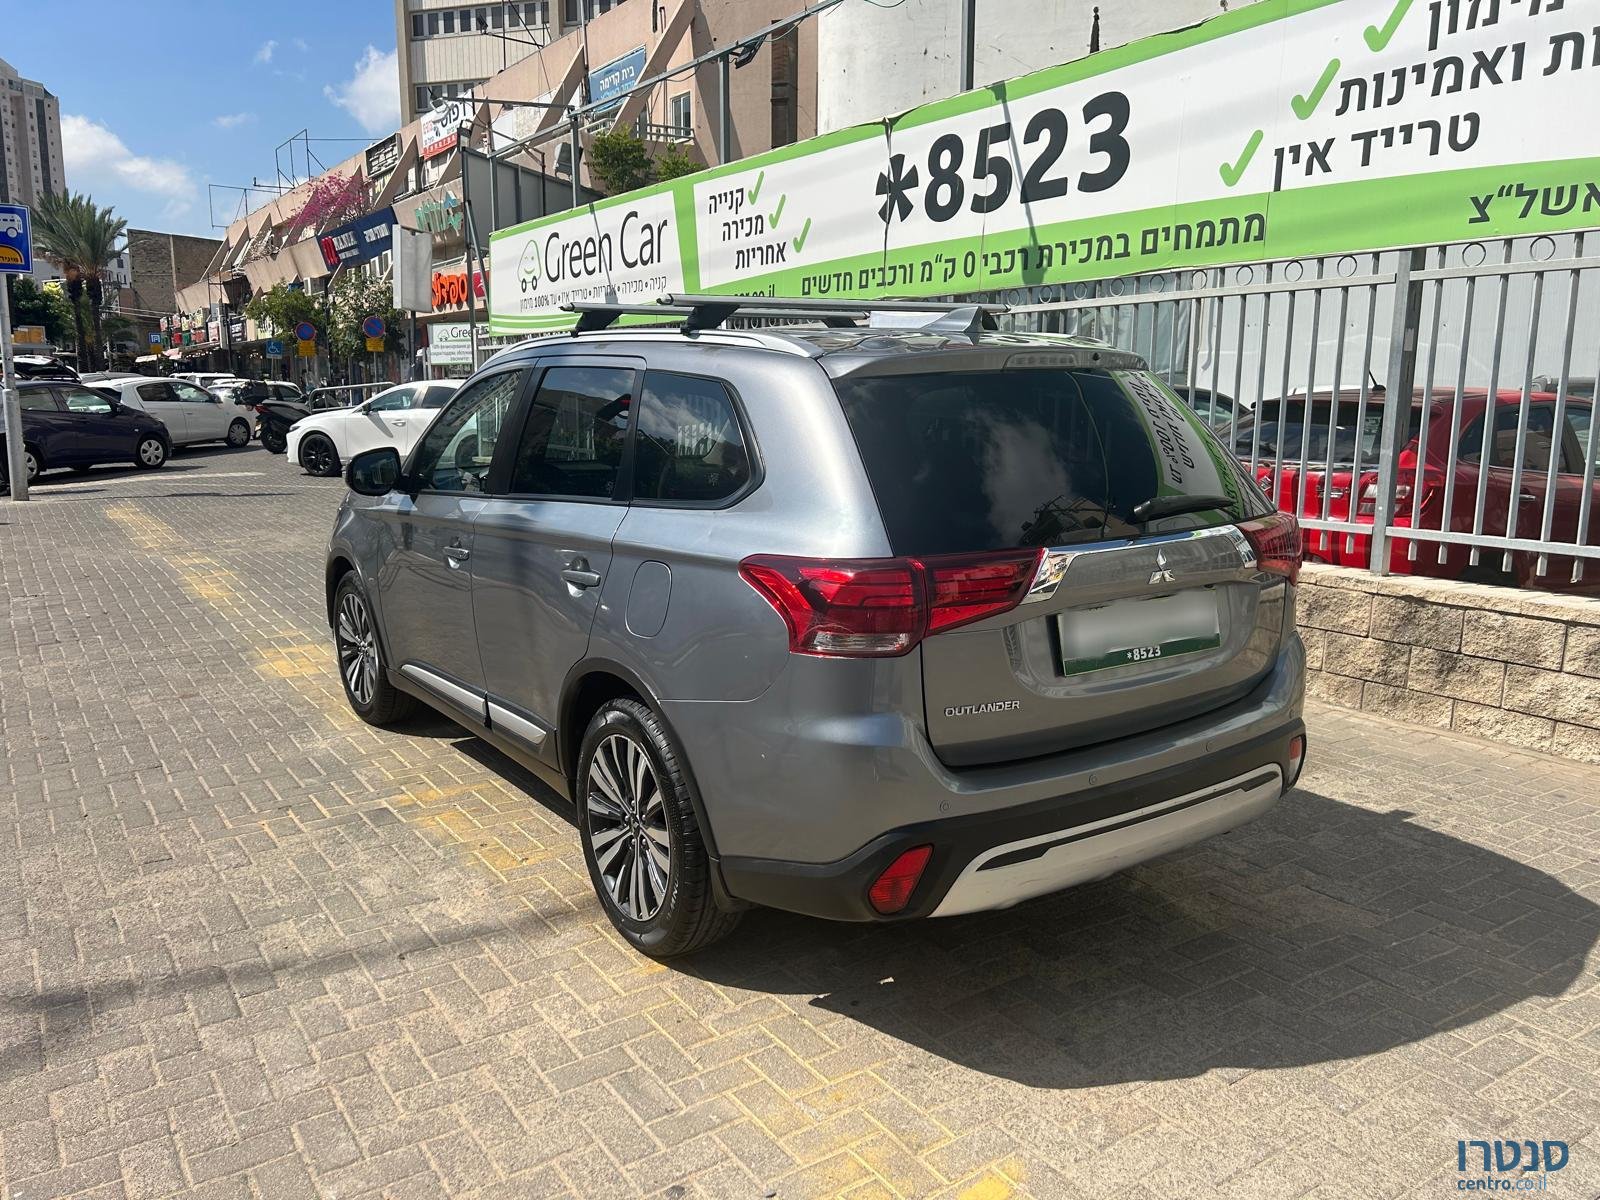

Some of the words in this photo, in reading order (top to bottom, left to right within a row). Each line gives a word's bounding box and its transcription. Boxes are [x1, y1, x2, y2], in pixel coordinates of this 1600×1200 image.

[1428, 0, 1563, 51] מון
[600, 72, 620, 92] קדימה
[622, 66, 634, 80] בית
[1335, 42, 1526, 116] ואמינות
[1351, 112, 1480, 167] טרייד
[1273, 137, 1336, 192] אין
[708, 188, 744, 214] קנייה
[722, 214, 764, 242] מכירה
[1140, 212, 1266, 255] מתמחים
[544, 232, 612, 282] Green
[620, 210, 668, 269] Car
[735, 242, 787, 270] אחריות
[1036, 233, 1130, 270] במכירת
[963, 250, 976, 278] 0
[983, 247, 1028, 276] רכבי
[622, 280, 644, 298] מכירה
[649, 276, 668, 296] קניה
[802, 272, 852, 296] חדשים
[858, 263, 914, 290] ורכבים
[534, 295, 550, 308] 100%
[944, 700, 1020, 718] OUTLANDER
